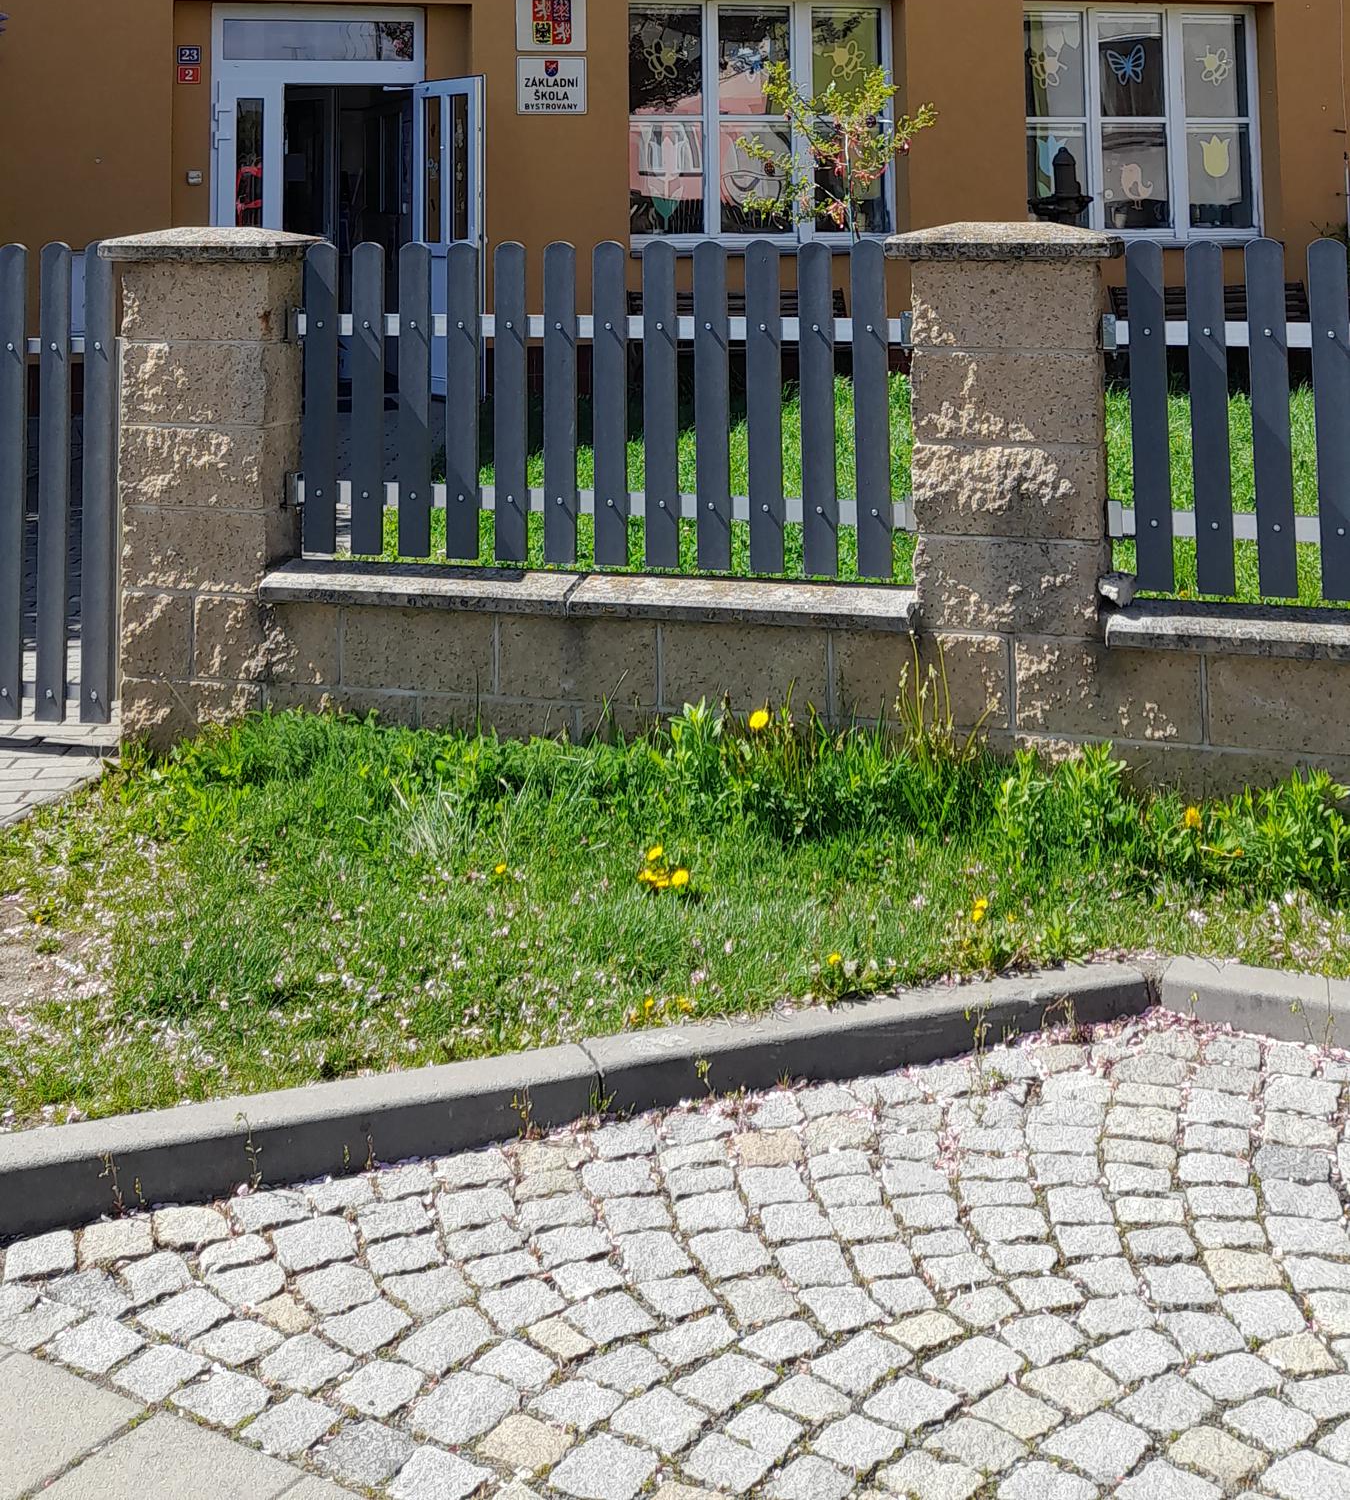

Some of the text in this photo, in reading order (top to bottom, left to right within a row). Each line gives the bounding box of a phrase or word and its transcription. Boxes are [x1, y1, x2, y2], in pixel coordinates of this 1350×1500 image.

[181, 49, 198, 61] 23
[184, 69, 193, 80] 2
[524, 76, 578, 88] ZÁKLADNÍ
[534, 89, 569, 101] ŠKOLA
